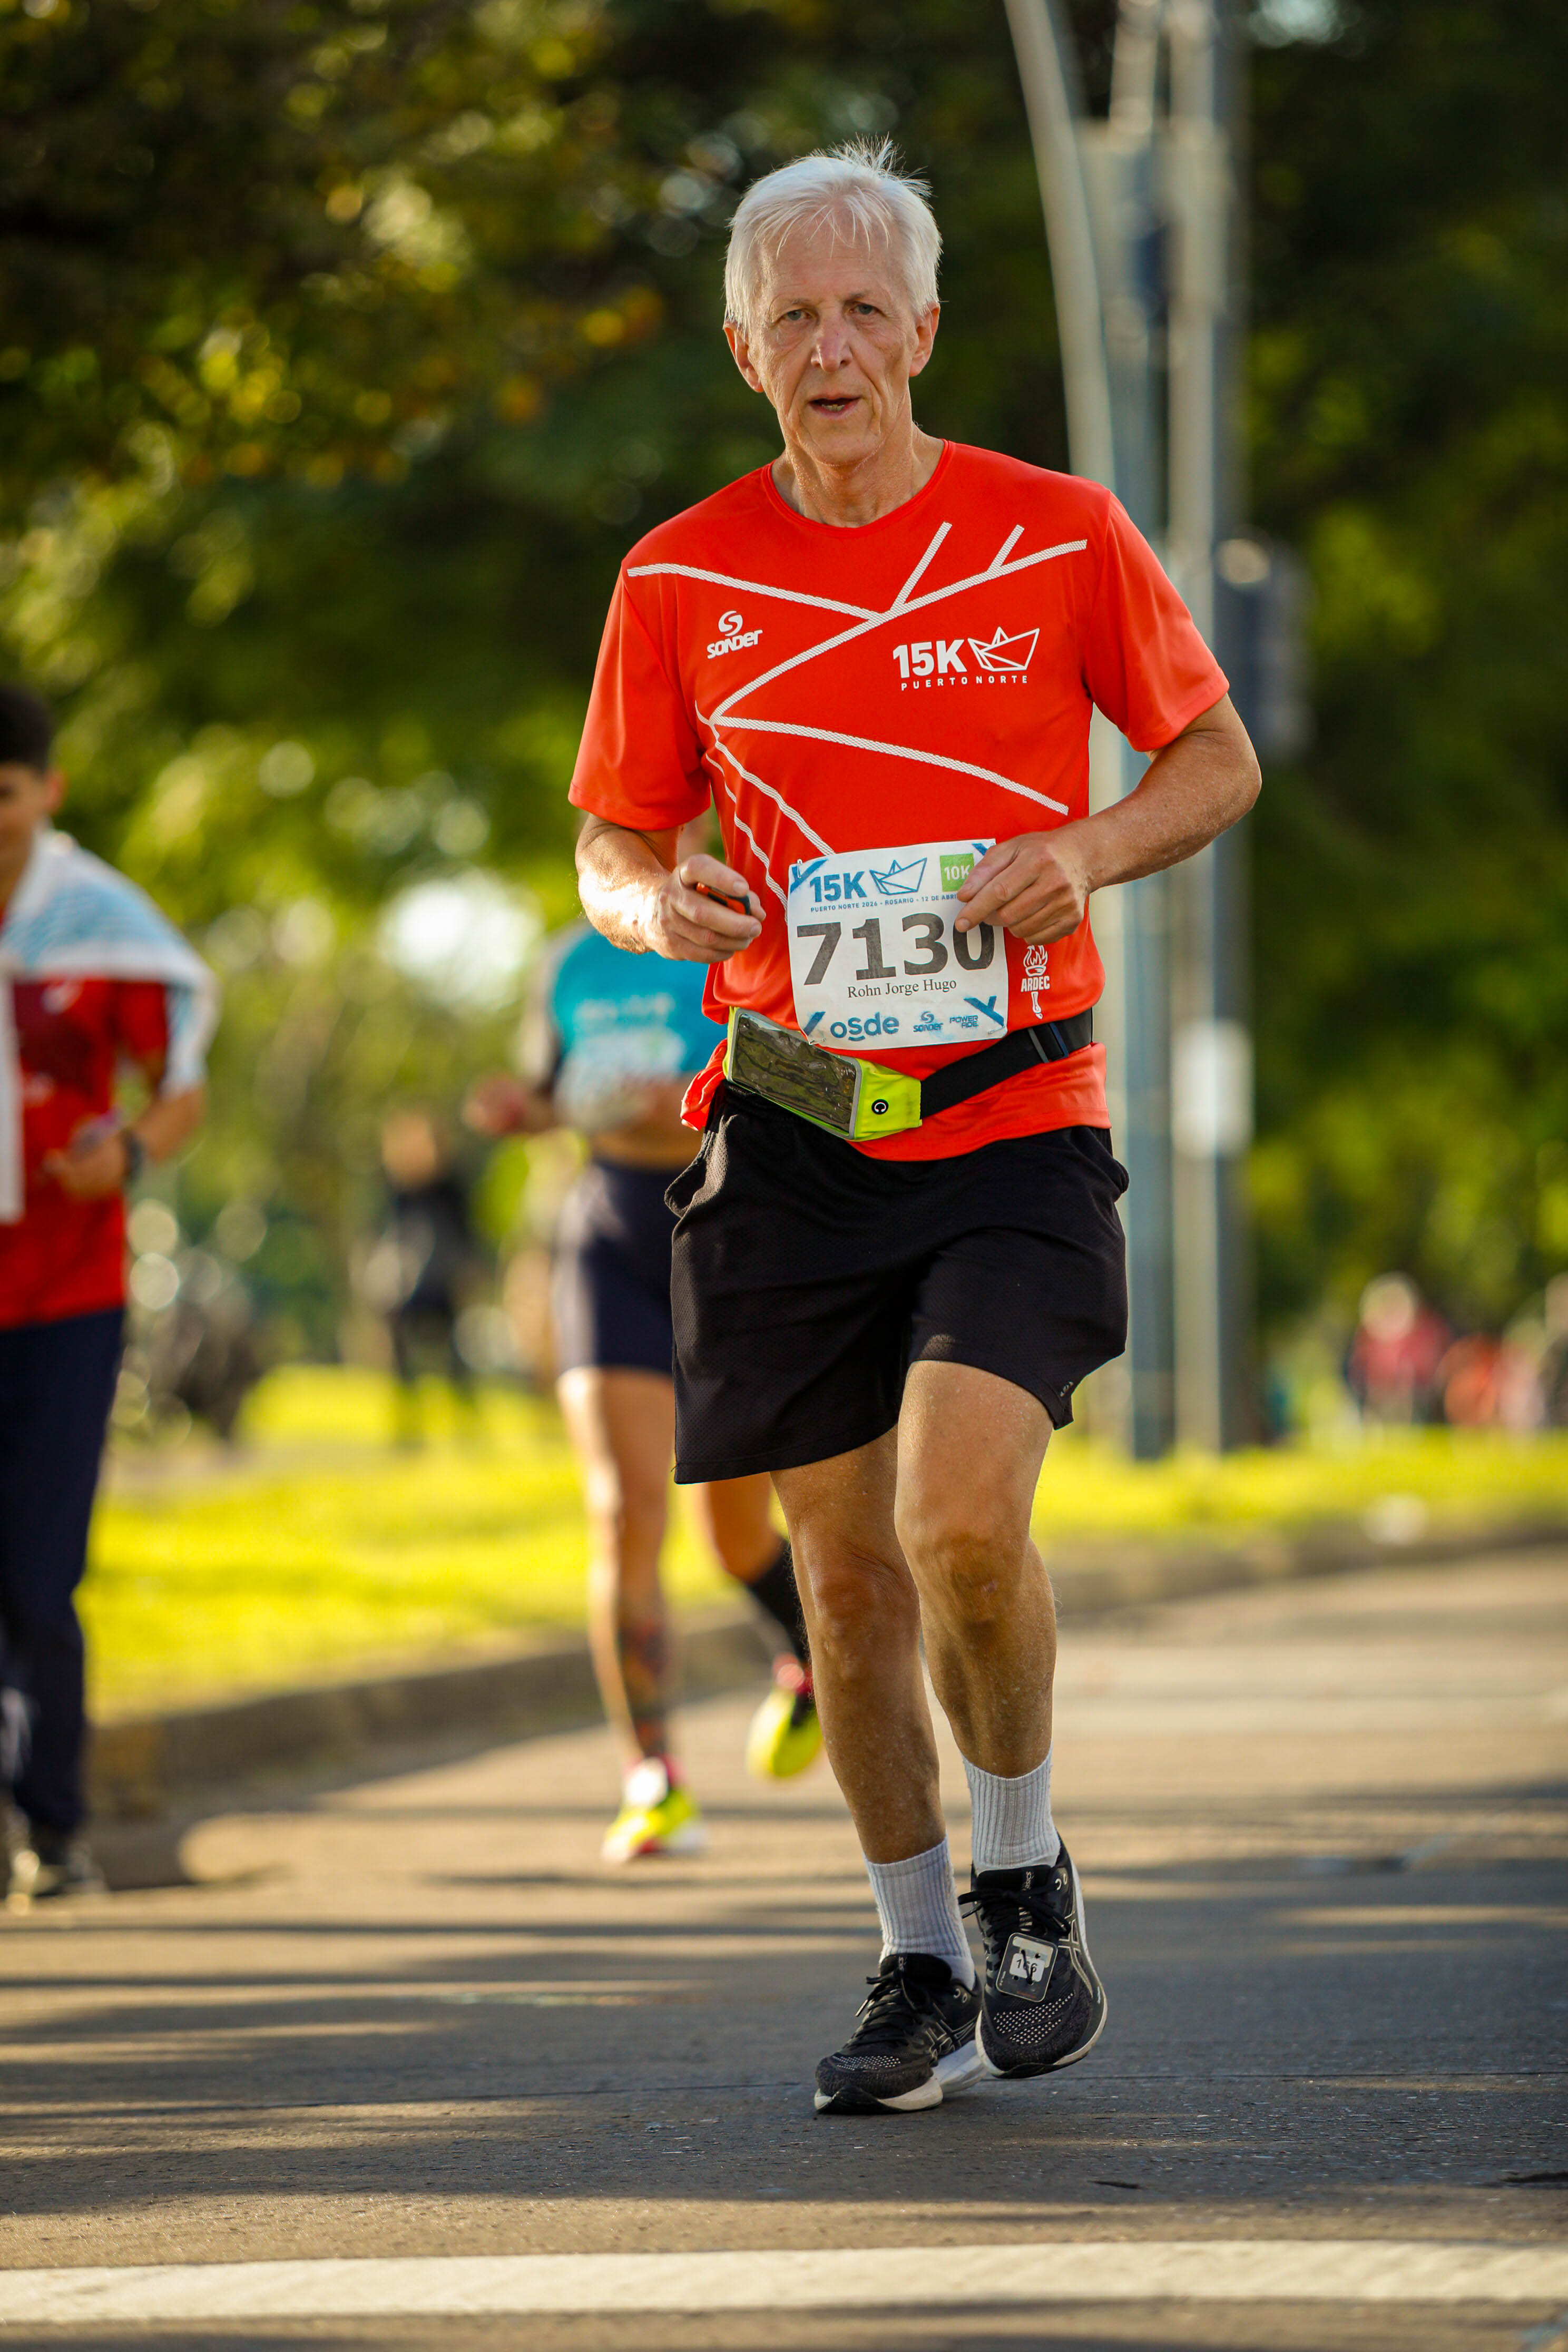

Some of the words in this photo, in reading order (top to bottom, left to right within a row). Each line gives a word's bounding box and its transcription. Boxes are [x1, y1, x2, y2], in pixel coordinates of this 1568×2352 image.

[893, 639, 967, 678] 15K
[901, 677, 968, 691] PUERTO
[976, 675, 1027, 684] NORTE
[944, 865, 971, 881] 10K
[810, 871, 867, 903] 15K
[797, 912, 995, 986] 7130
[847, 984, 881, 998] Rohn
[885, 983, 919, 996] Jorge
[923, 978, 957, 993] Hugo
[1021, 976, 1050, 992] ARDEC
[830, 1012, 899, 1041] osde
[949, 1015, 978, 1024] POWER
